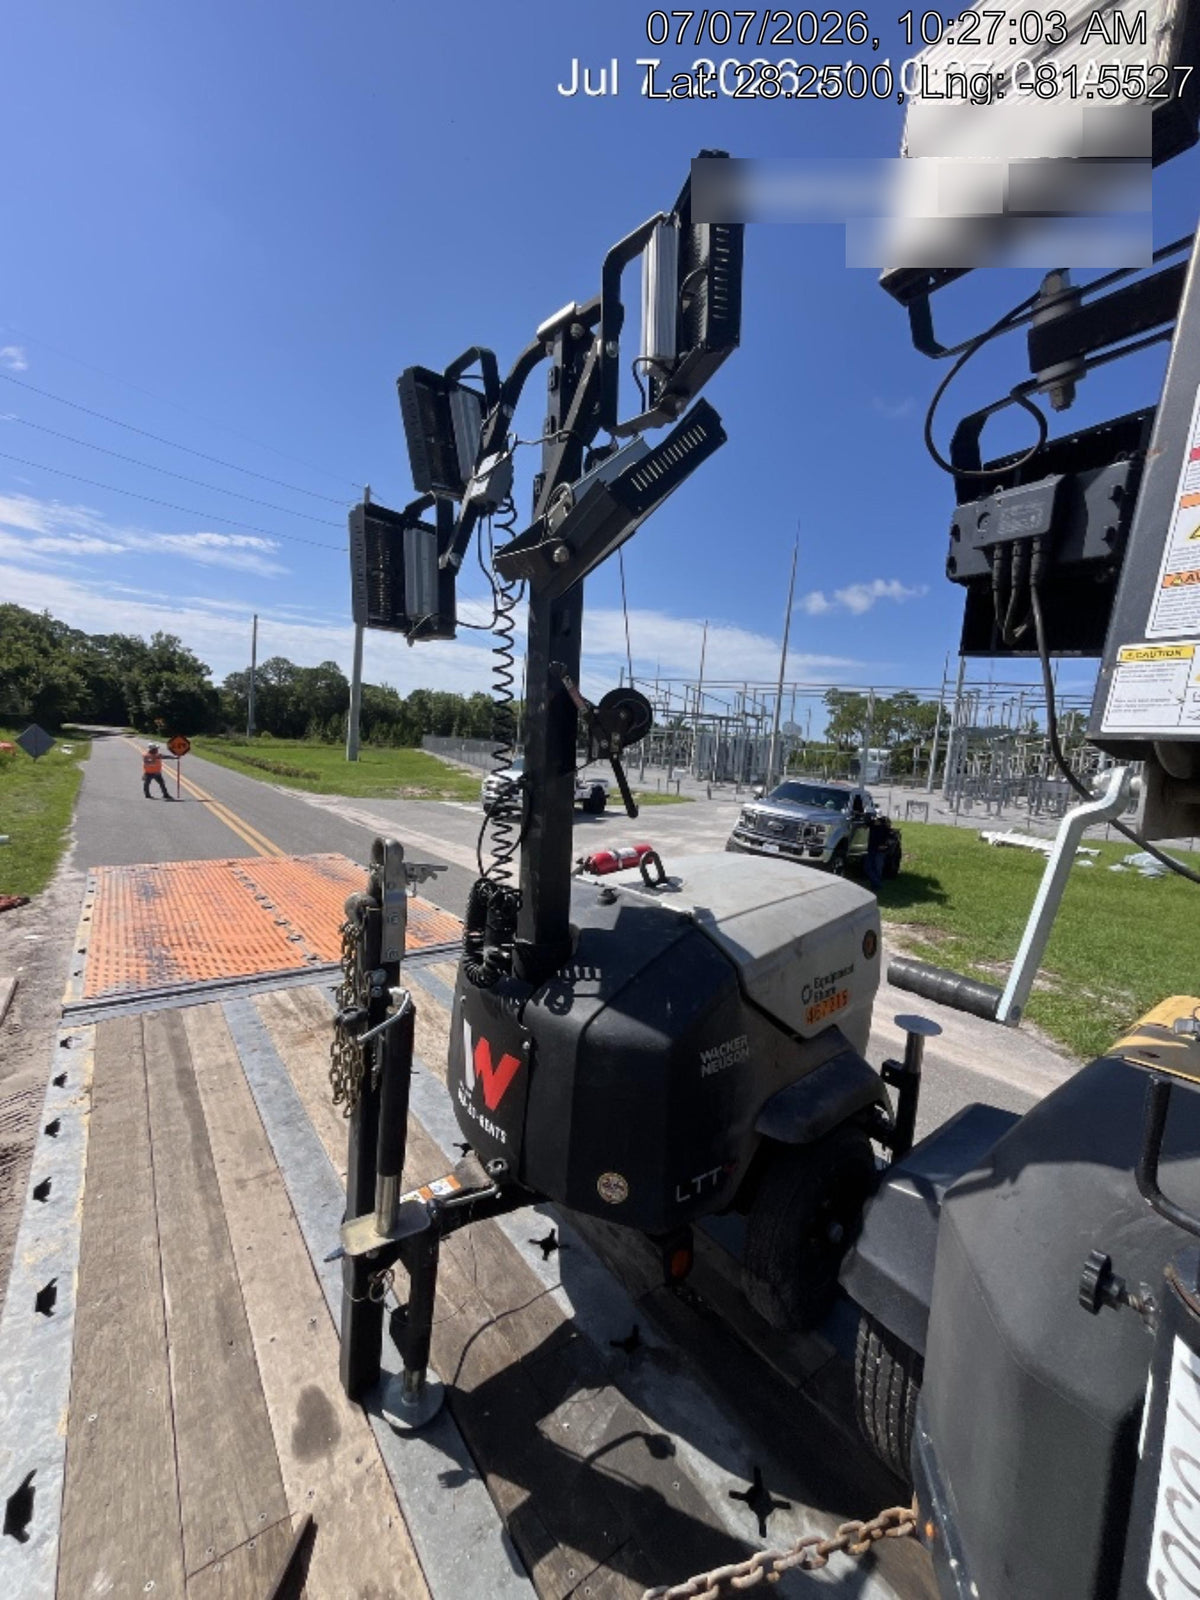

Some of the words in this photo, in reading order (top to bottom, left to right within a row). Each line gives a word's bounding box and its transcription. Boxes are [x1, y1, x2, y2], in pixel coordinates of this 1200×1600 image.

[1135, 650, 1182, 660] CAUTION
[699, 1034, 748, 1065] WACKER
[700, 1045, 750, 1079] NEUSON
